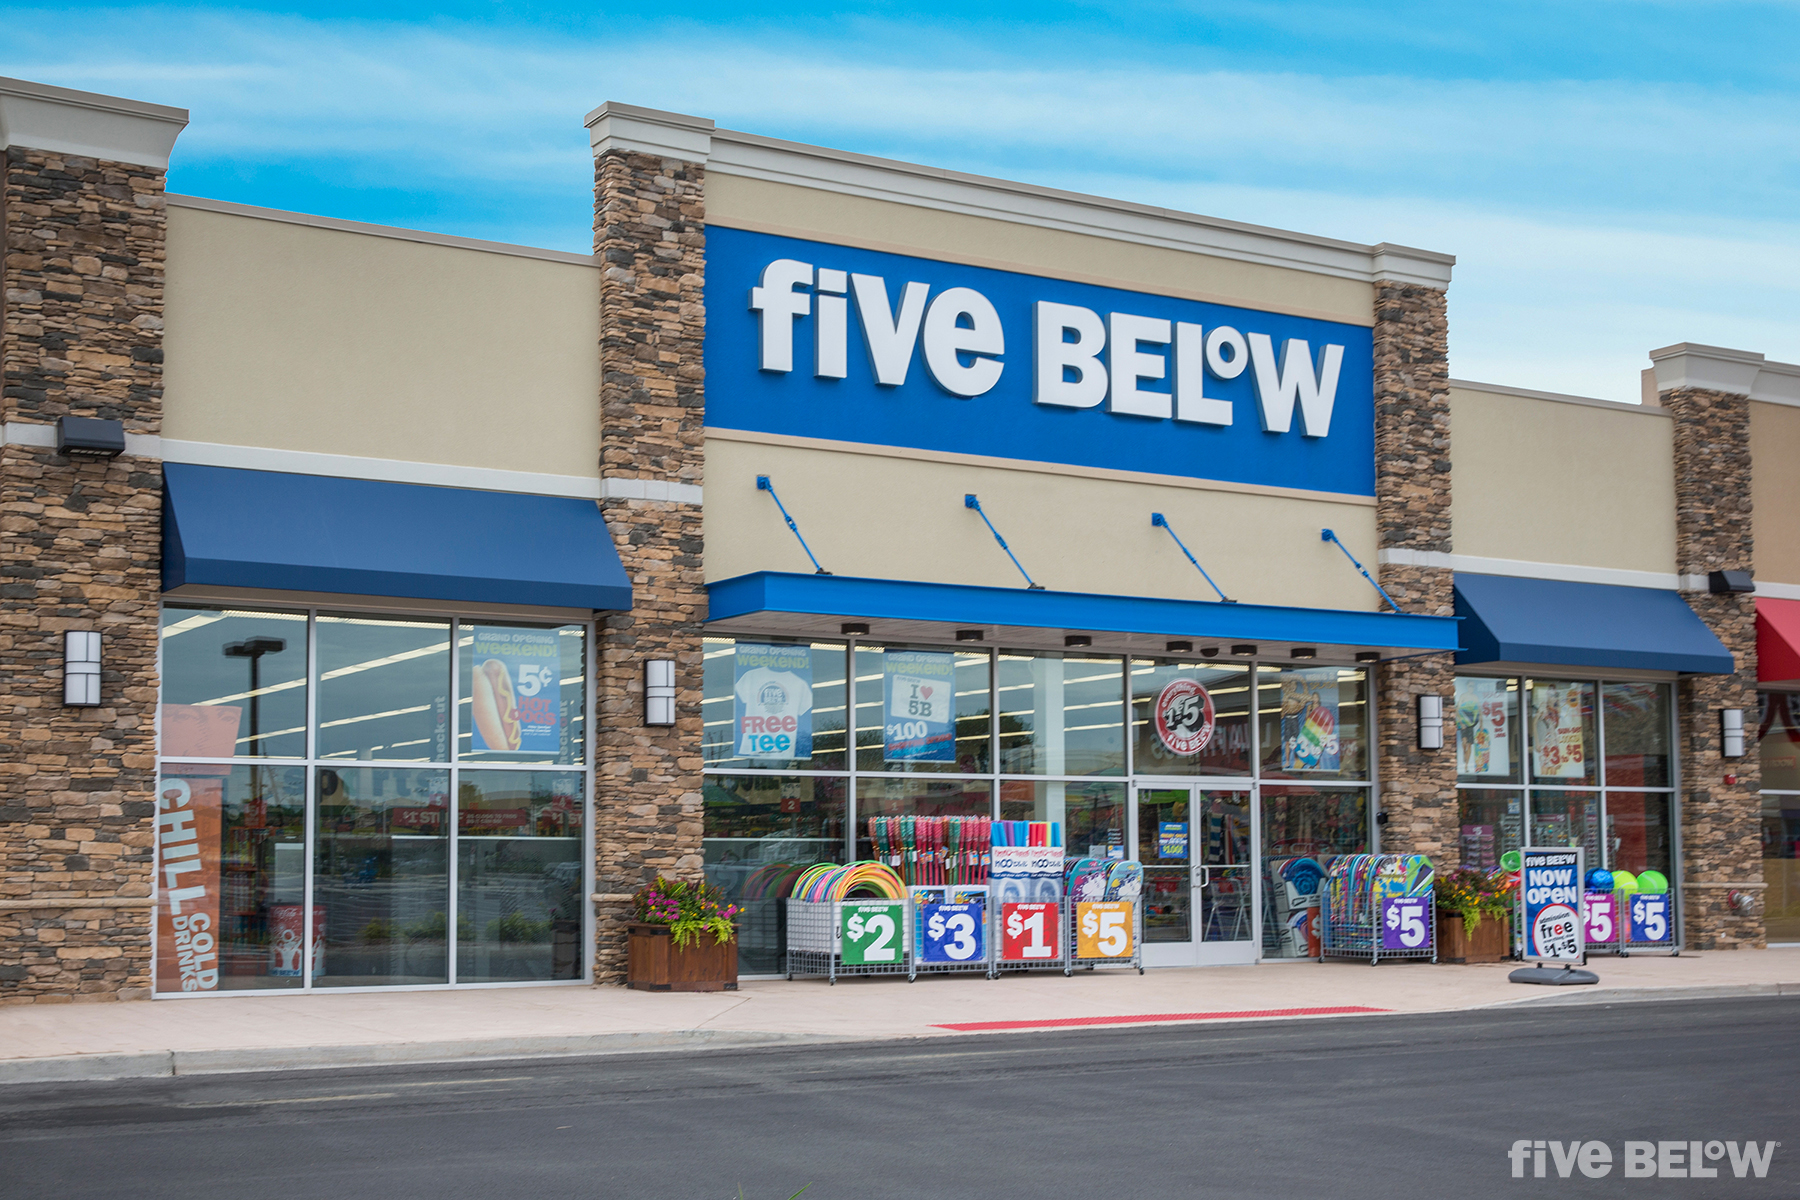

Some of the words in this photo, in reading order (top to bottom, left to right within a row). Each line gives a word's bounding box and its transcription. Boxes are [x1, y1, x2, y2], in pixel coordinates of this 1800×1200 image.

[748, 258, 1005, 399] five
[510, 708, 557, 725] DOGS
[518, 696, 552, 712] HOT
[908, 700, 932, 717] 5B
[1482, 701, 1505, 727] $5
[886, 721, 928, 742] $100
[1289, 735, 1310, 758] $3
[1319, 734, 1339, 756] $5
[1543, 746, 1561, 765] $3
[1566, 744, 1584, 763] $5
[787, 800, 796, 811] 2
[891, 801, 899, 811] 1
[160, 778, 207, 916] CHILL
[1529, 869, 1573, 887] NOW
[1081, 910, 1128, 957] $5
[1386, 904, 1426, 947] $5
[1541, 921, 1573, 939] free
[1633, 900, 1666, 941] $5
[846, 913, 896, 962] $2
[927, 912, 977, 960] $3
[1006, 910, 1052, 958] $1
[172, 915, 198, 992] DRINKS
[188, 912, 219, 990] COLD
